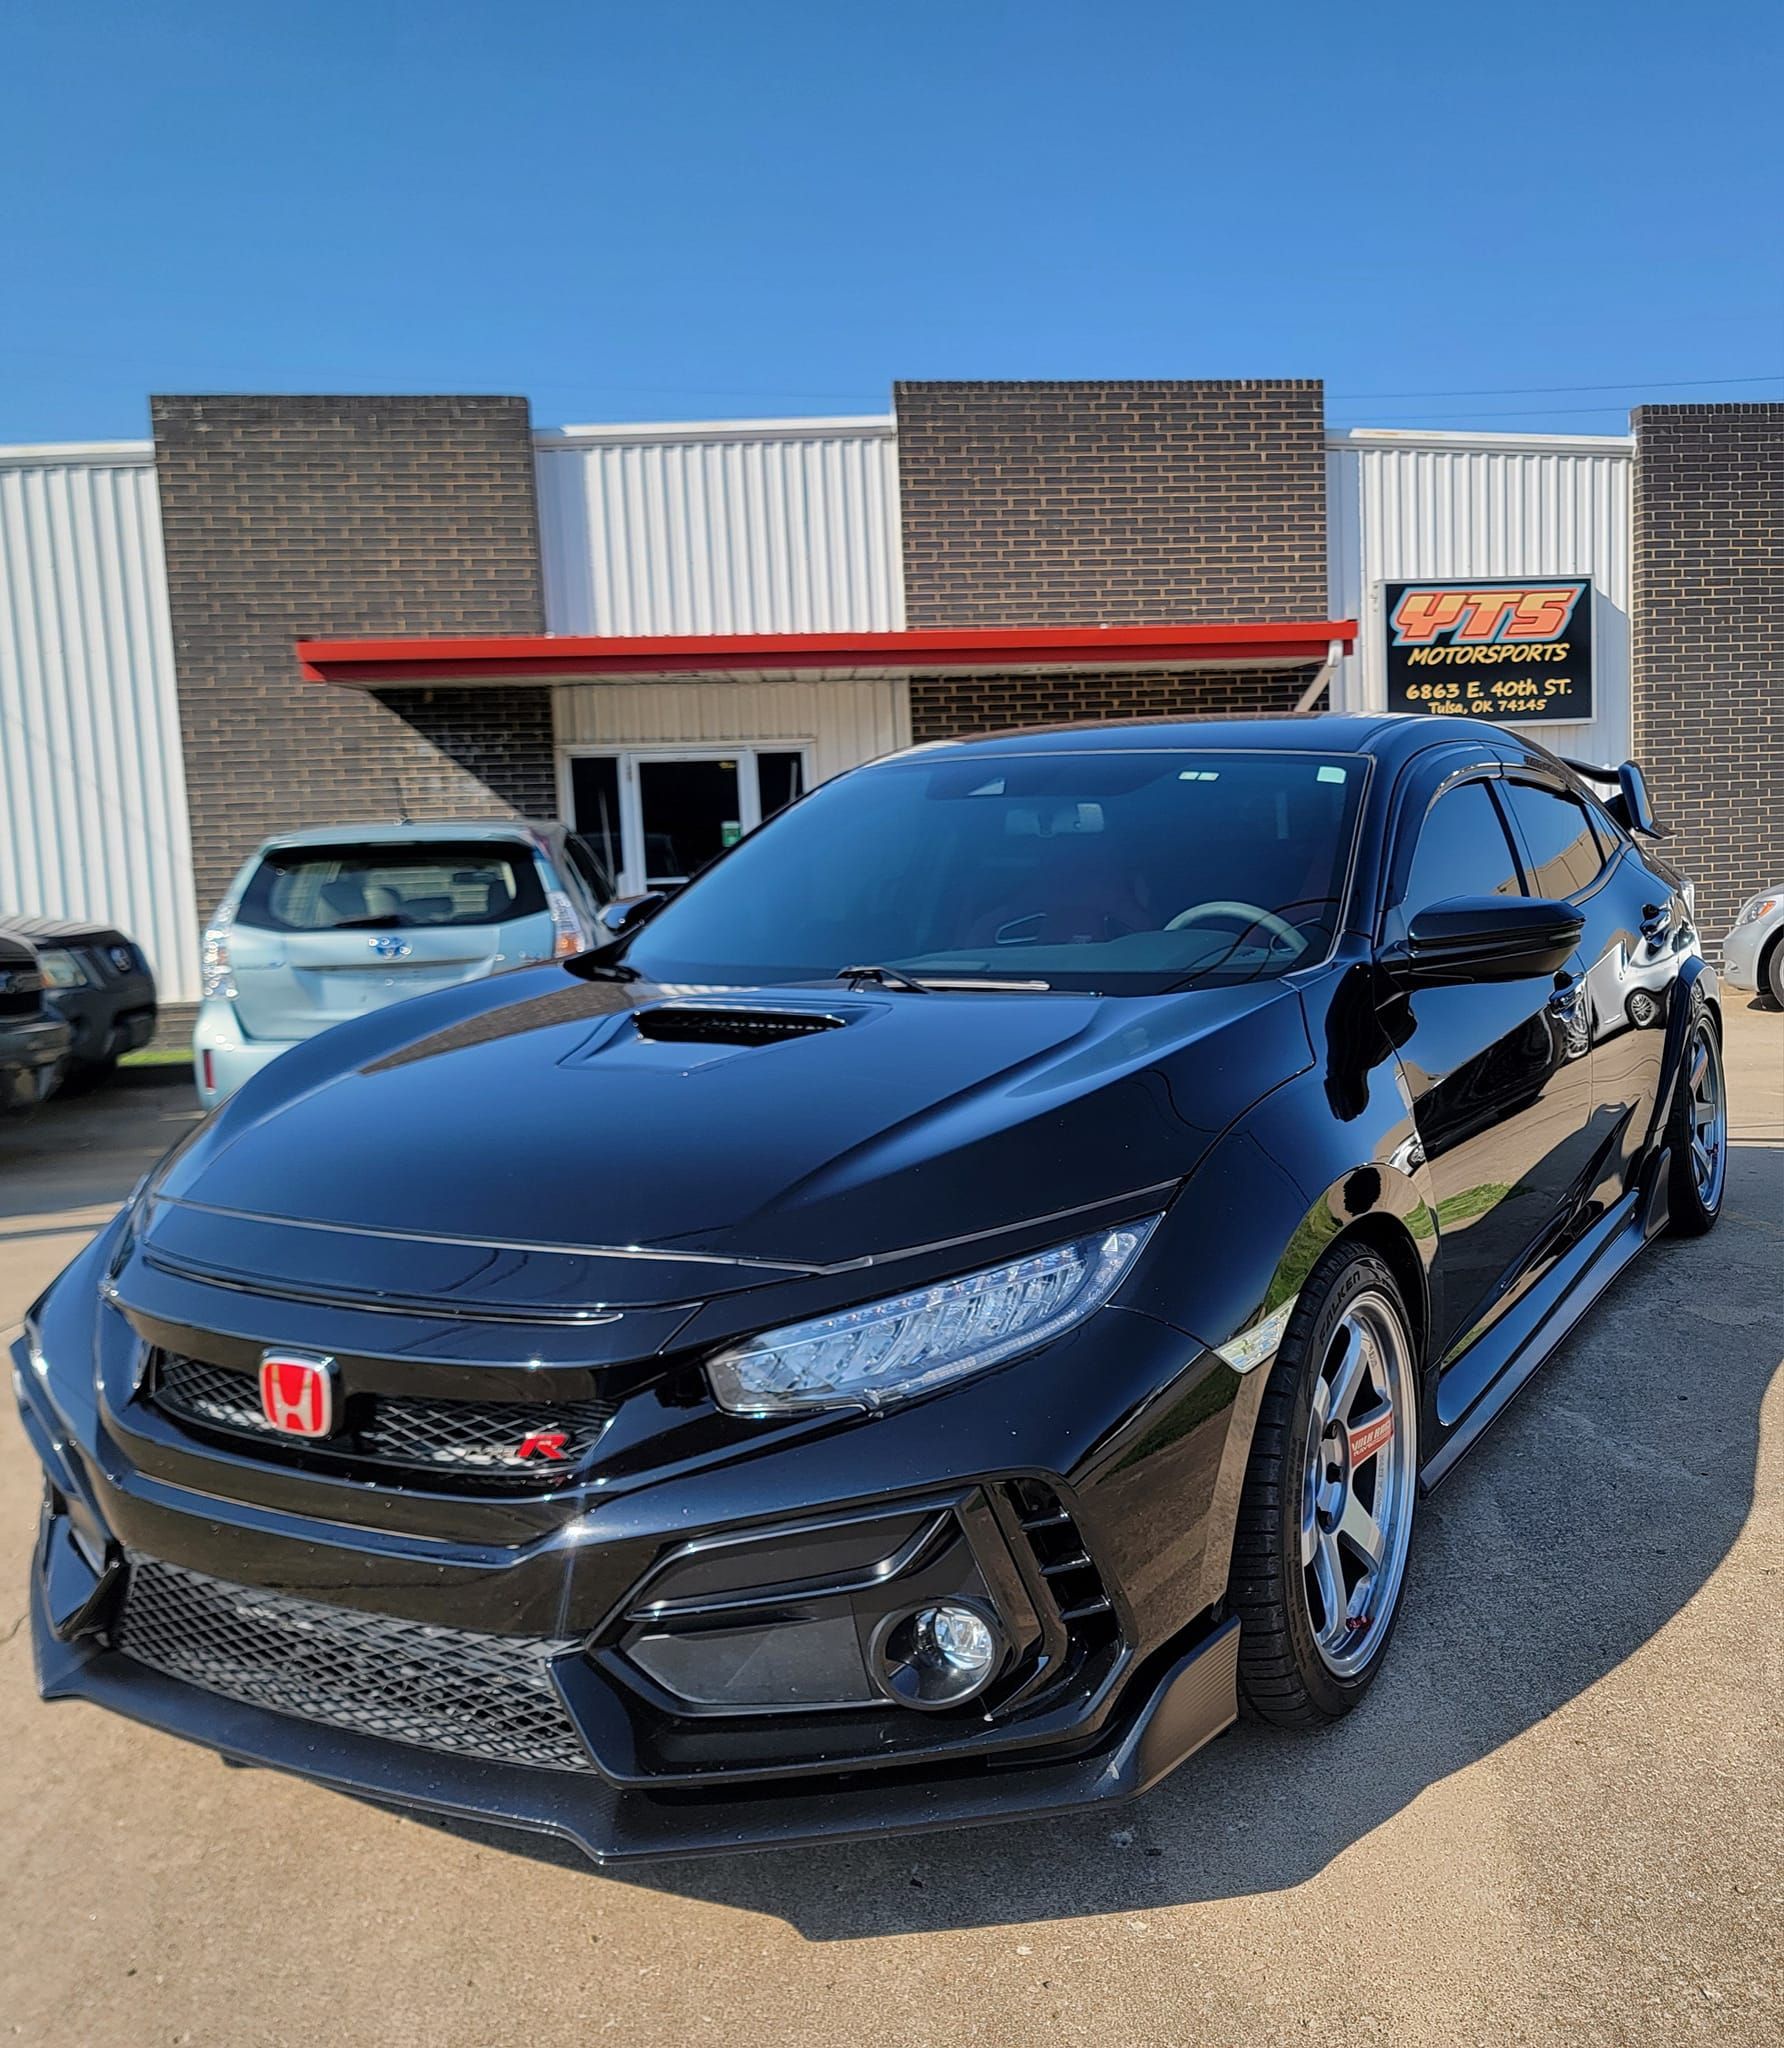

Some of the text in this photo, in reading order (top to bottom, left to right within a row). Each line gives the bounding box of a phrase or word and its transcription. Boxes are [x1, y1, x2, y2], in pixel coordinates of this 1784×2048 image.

[1392, 585, 1584, 644] YTS
[1407, 643, 1570, 665] MOTORSPORTS
[1406, 679, 1573, 700] 6863 E. 40th ST.
[1428, 698, 1547, 715] Tulsa, OK 74145
